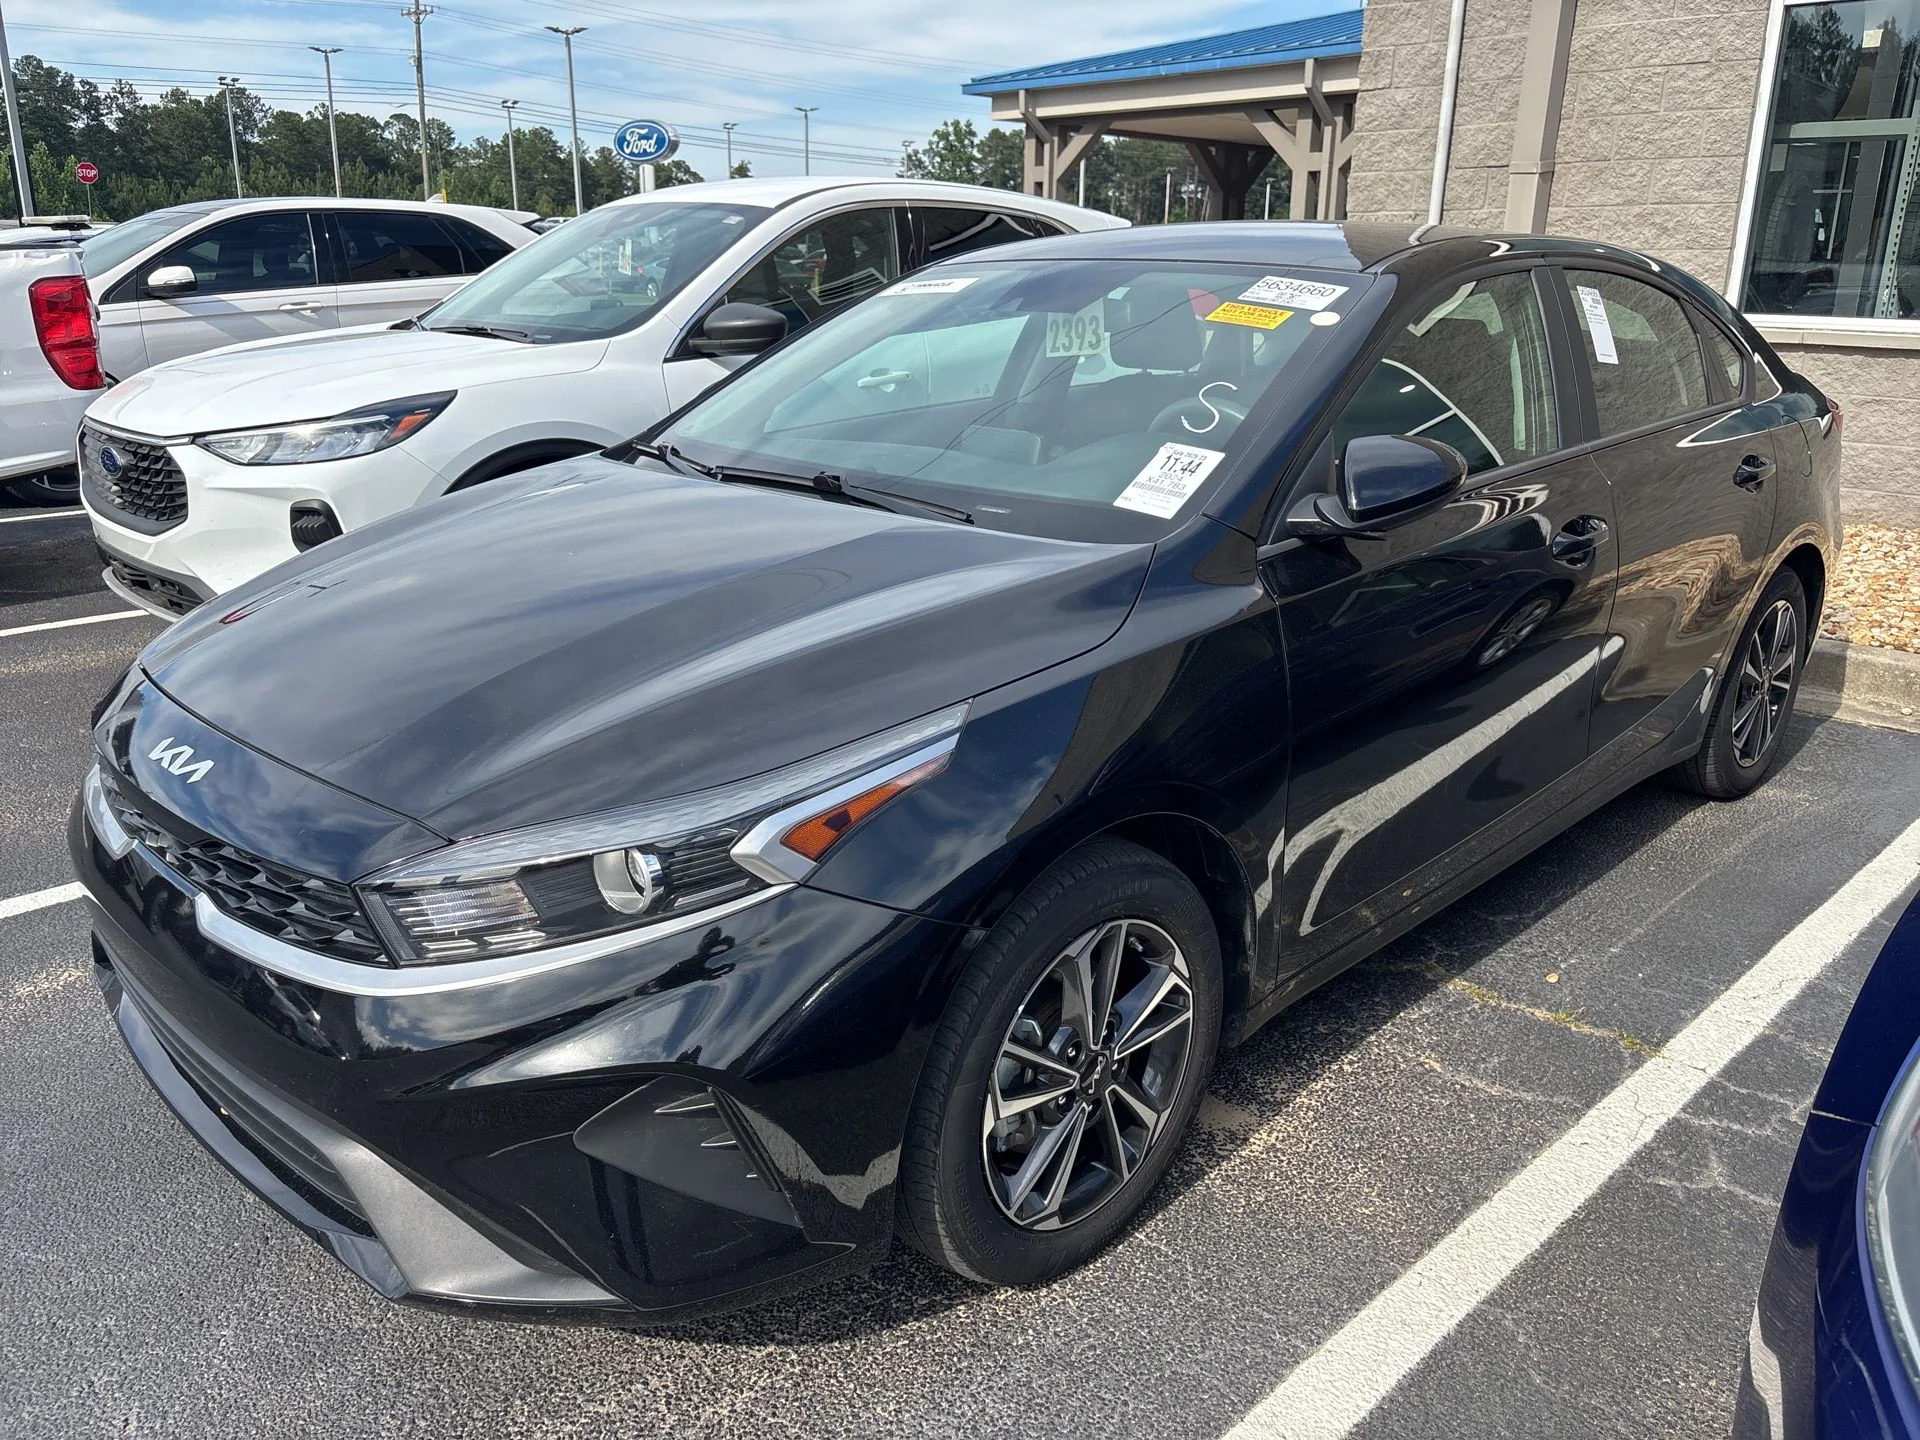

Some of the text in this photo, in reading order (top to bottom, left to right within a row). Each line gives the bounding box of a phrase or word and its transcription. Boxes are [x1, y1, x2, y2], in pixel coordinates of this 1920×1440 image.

[623, 128, 658, 154] Ford
[77, 168, 97, 178] STOP
[1256, 279, 1337, 298] 5634660
[1225, 303, 1288, 317] THIS VEHICLE
[1257, 312, 1279, 320] SALE
[1049, 314, 1102, 353] 2393
[1158, 471, 1184, 483] 2024
